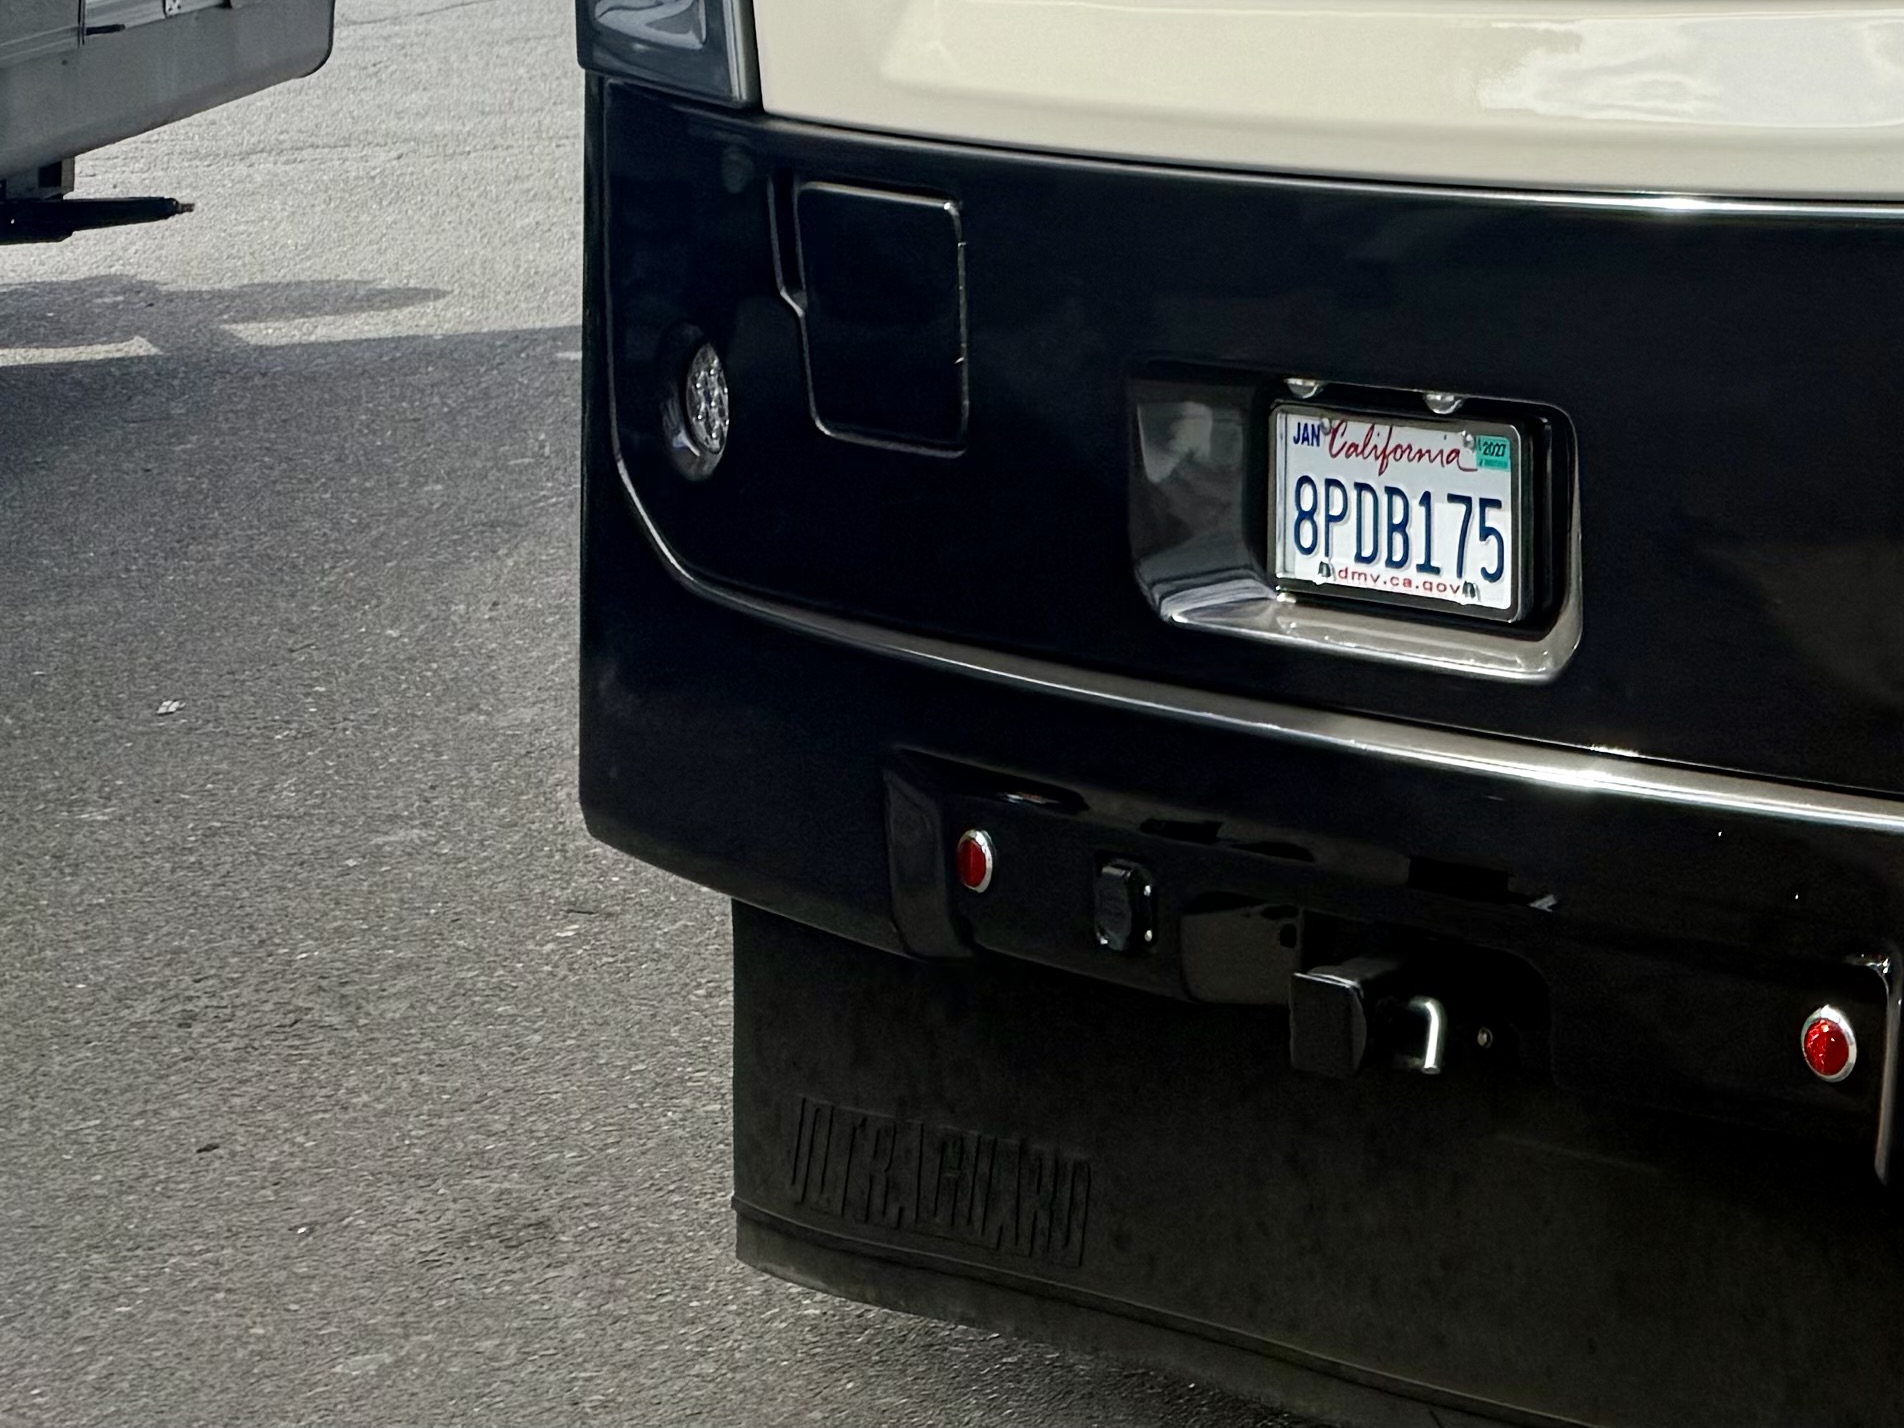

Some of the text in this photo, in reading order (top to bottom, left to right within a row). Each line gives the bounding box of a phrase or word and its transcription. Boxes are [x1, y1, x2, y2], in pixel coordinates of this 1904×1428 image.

[1293, 421, 1321, 448] JAN
[1328, 418, 1478, 477] California
[1293, 474, 1505, 584] 8PDB175
[1337, 565, 1460, 596] dmv.ca.gov
